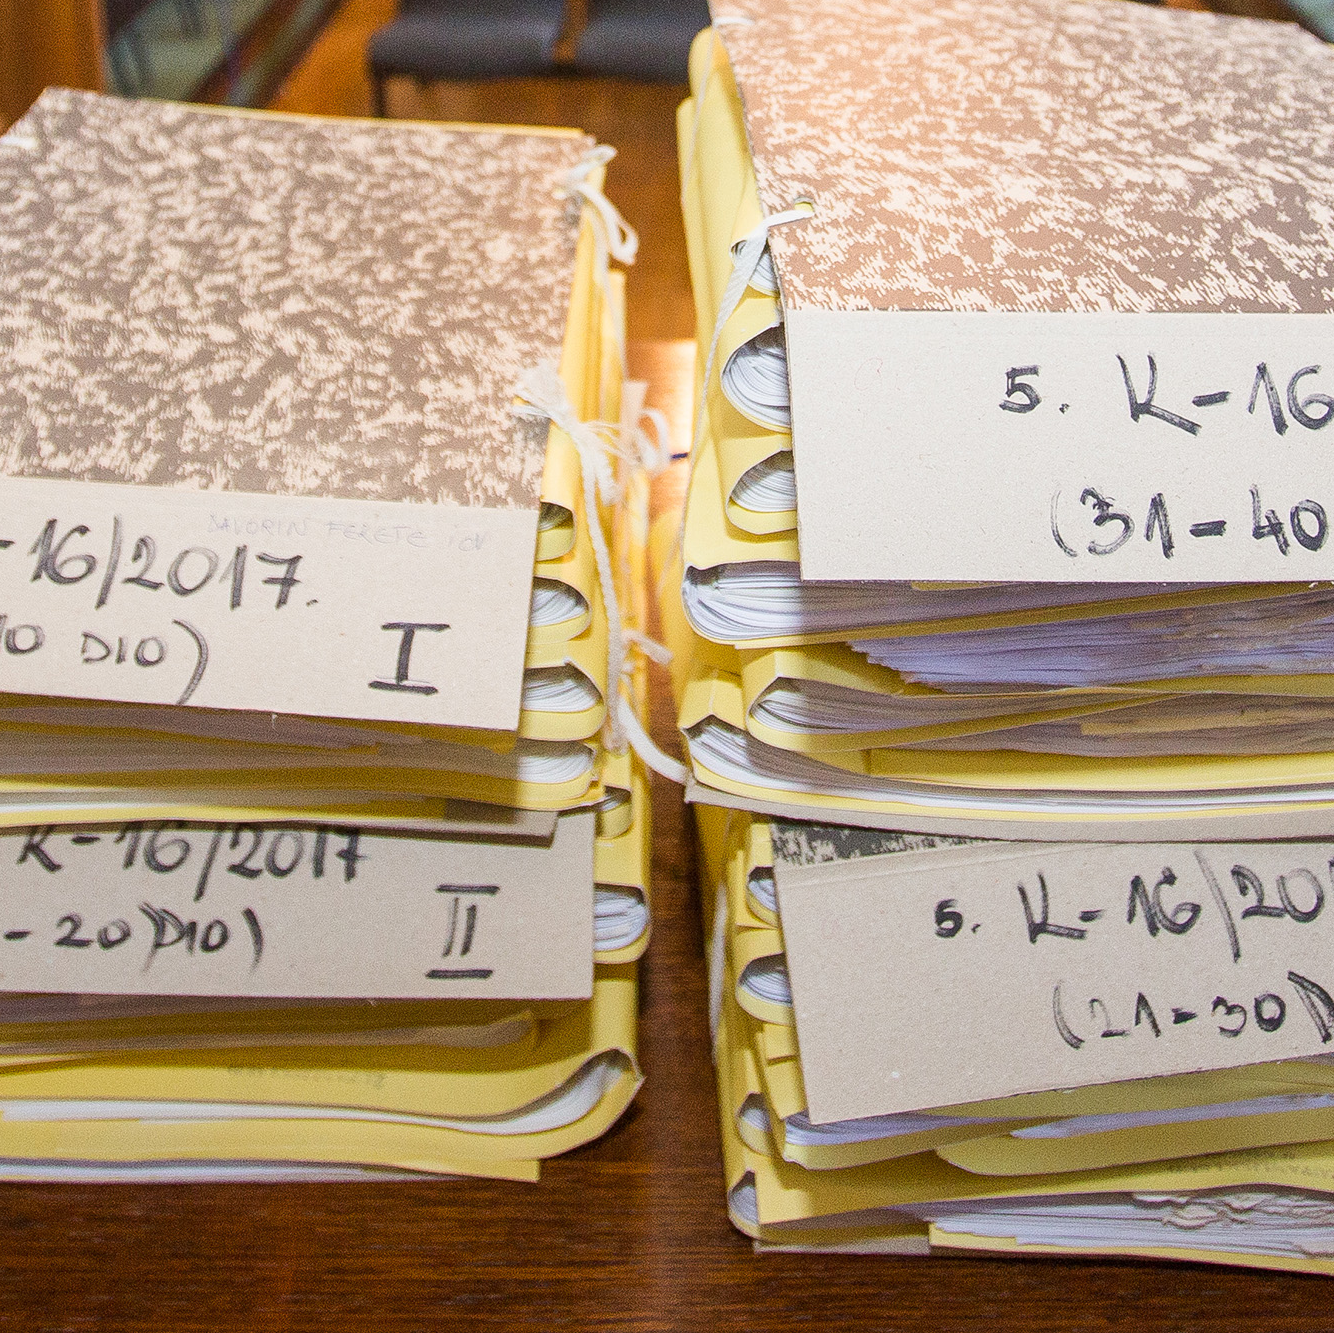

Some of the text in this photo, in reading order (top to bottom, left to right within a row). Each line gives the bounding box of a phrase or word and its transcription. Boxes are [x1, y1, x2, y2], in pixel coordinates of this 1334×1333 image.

[997, 366, 1069, 415] 5.
[366, 619, 453, 697] I
[424, 882, 501, 980] II
[933, 897, 982, 940] 5.
